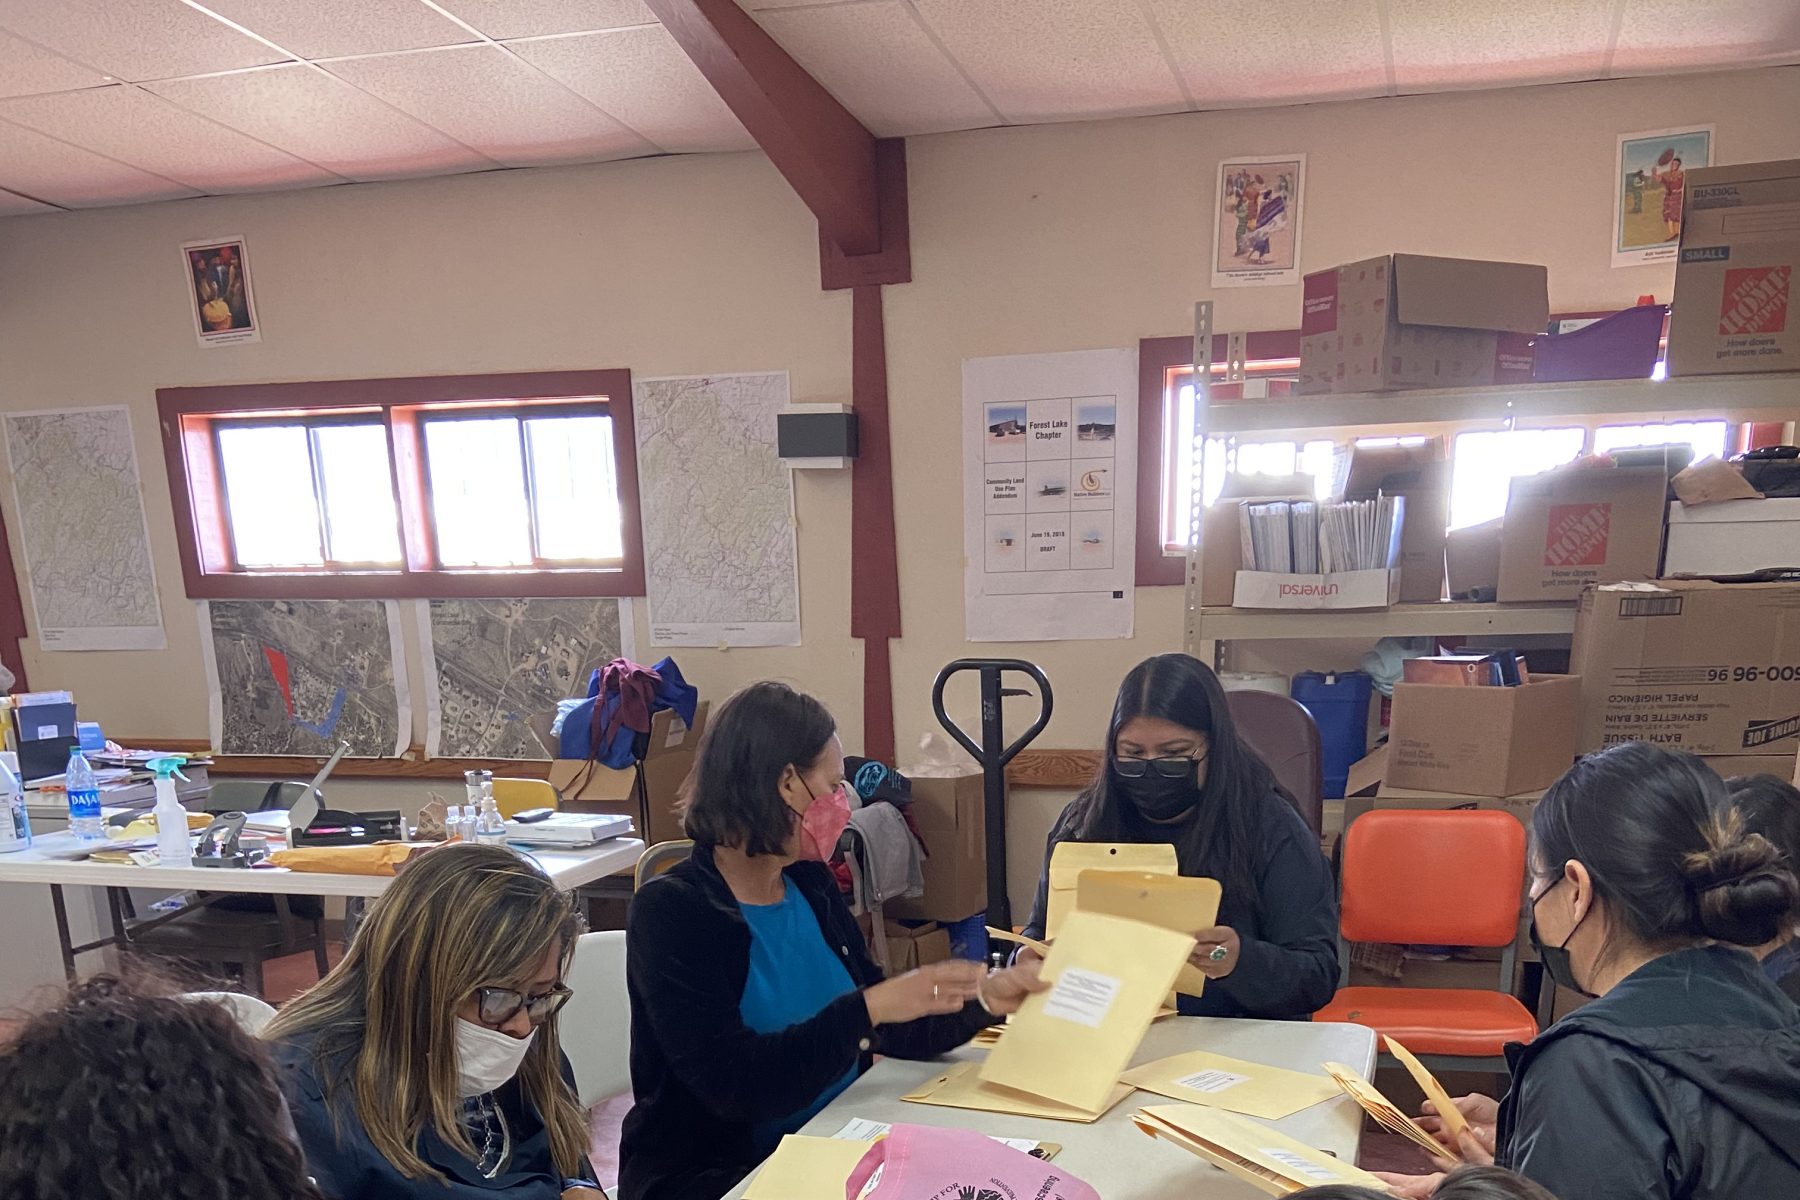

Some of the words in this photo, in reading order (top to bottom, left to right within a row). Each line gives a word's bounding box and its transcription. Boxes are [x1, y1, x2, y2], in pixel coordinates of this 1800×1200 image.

[1686, 250, 1725, 261] SMALL
[1719, 267, 1786, 334] HOME
[1744, 288, 1786, 333] DEPOT
[1030, 421, 1050, 429] Forest
[1052, 420, 1068, 428] Lake
[1035, 432, 1062, 440] Chapter
[1546, 505, 1608, 565] HOME
[1279, 584, 1339, 598] universal
[1708, 669, 1728, 681] 96
[1665, 694, 1699, 703] PAPEL
[1605, 715, 1630, 723] BAIN
[1651, 714, 1708, 722] SERVIETTE
[1650, 733, 1682, 743] BATH
[1747, 727, 1768, 746] JOE
[940, 1182, 961, 1196] FOR
